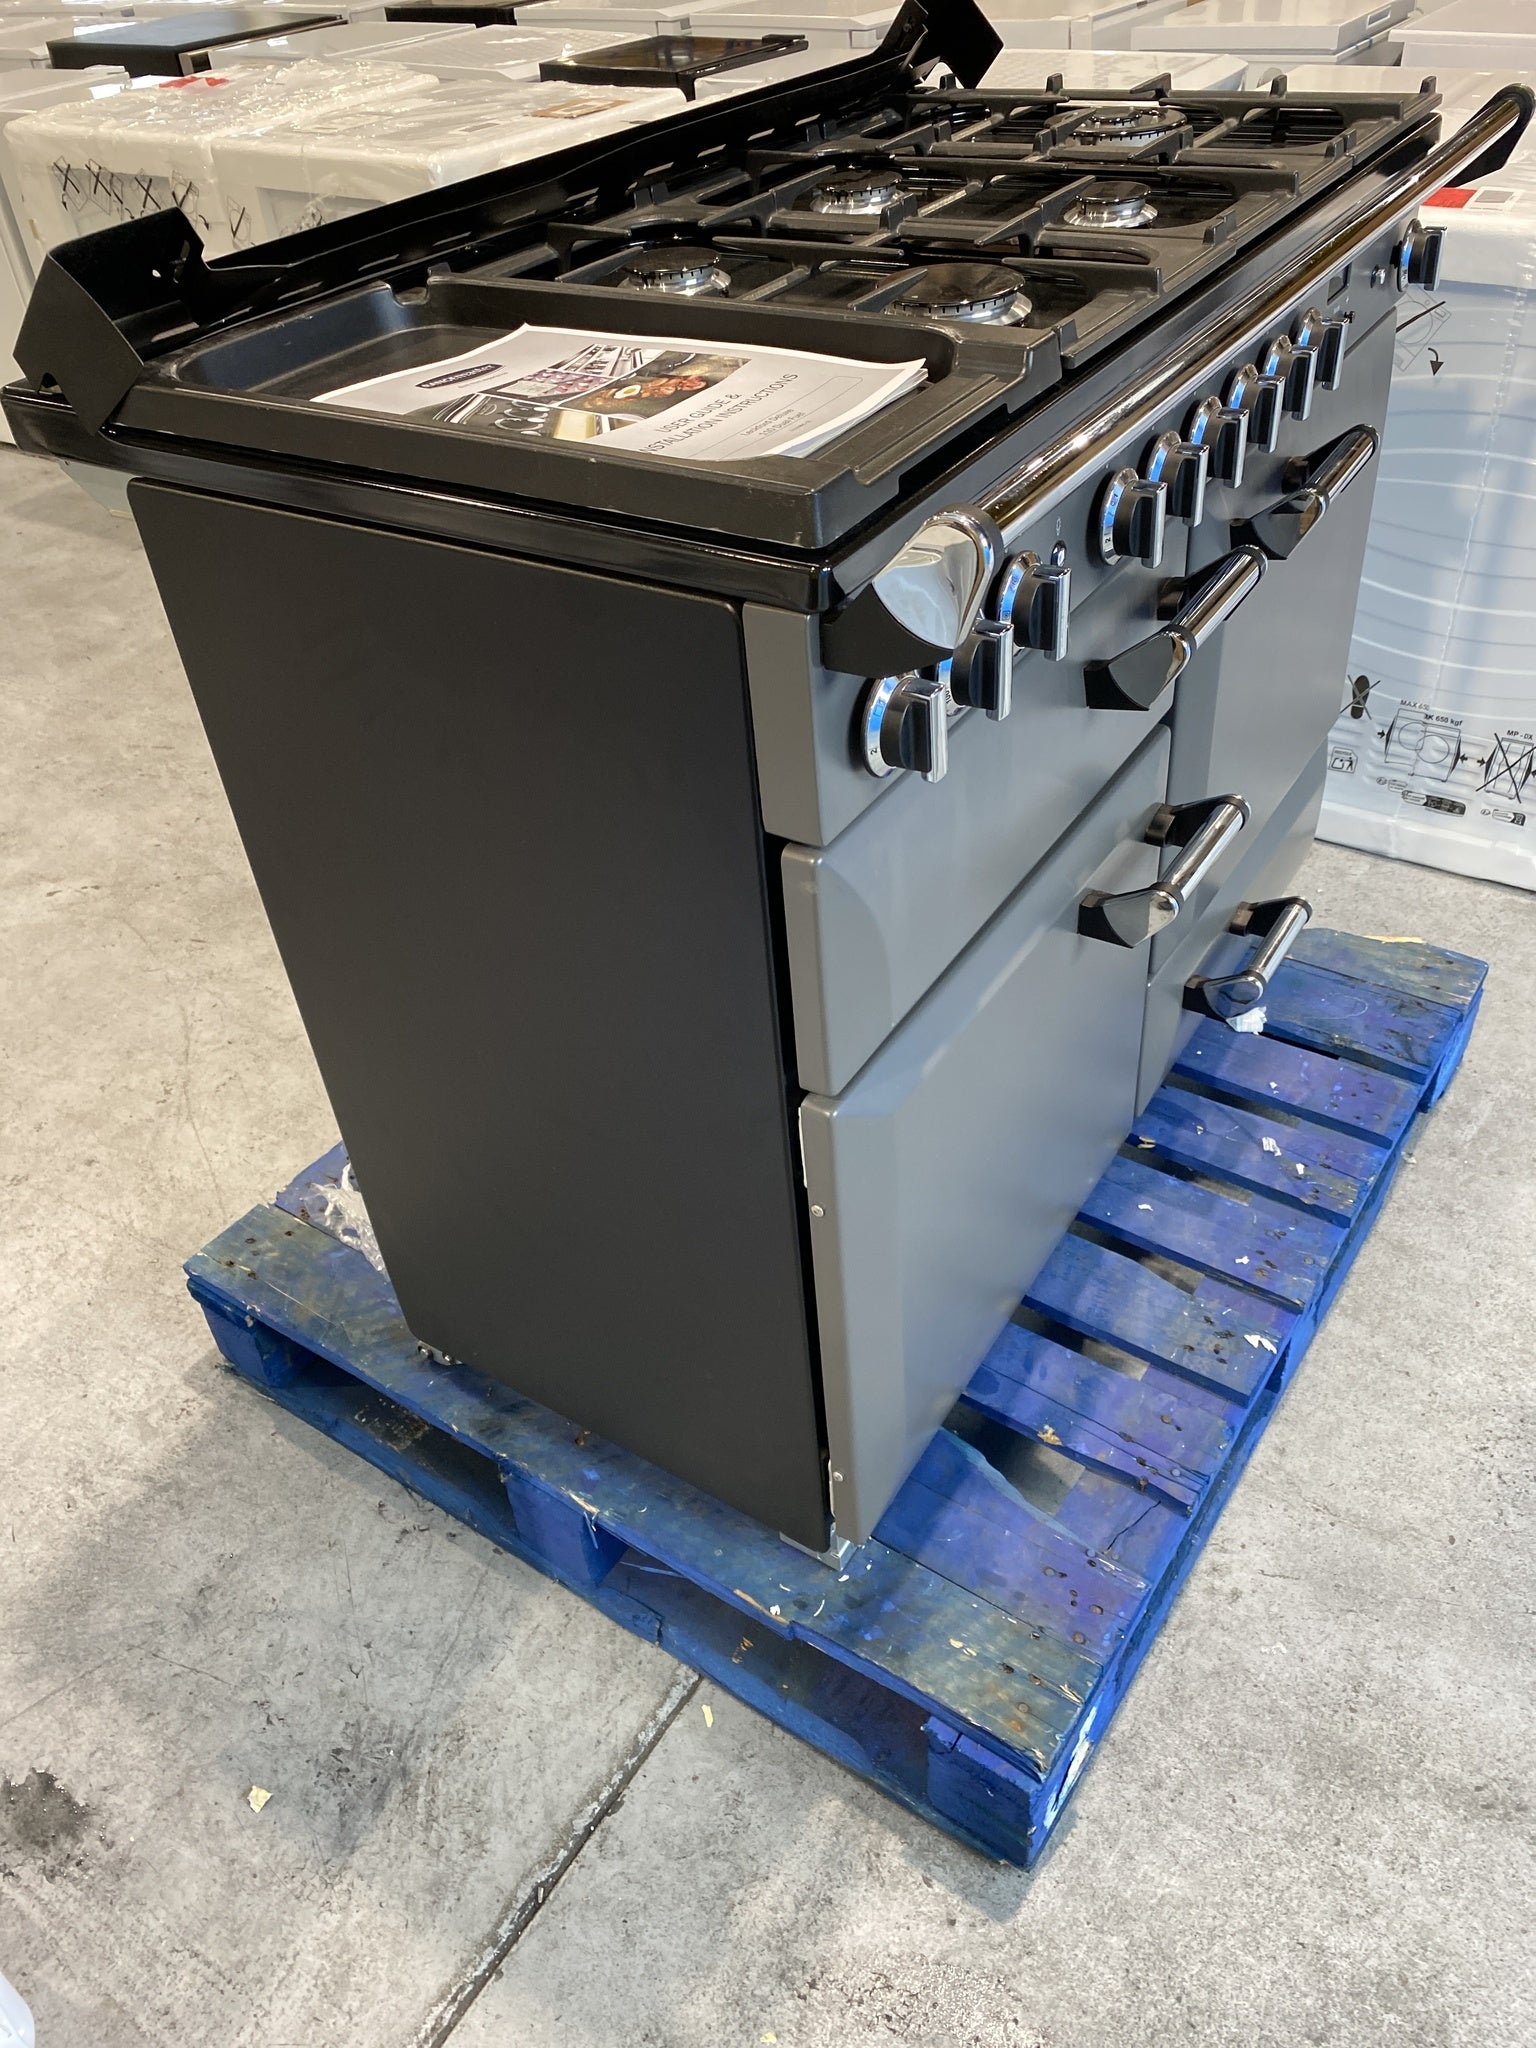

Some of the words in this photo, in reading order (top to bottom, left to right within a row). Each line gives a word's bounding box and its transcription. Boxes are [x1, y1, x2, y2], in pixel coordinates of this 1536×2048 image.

[638, 418, 723, 453] NSTALLATION
[715, 374, 798, 418] INSTRUCTIONS
[654, 417, 695, 433] USER
[690, 399, 731, 418] GUIDE
